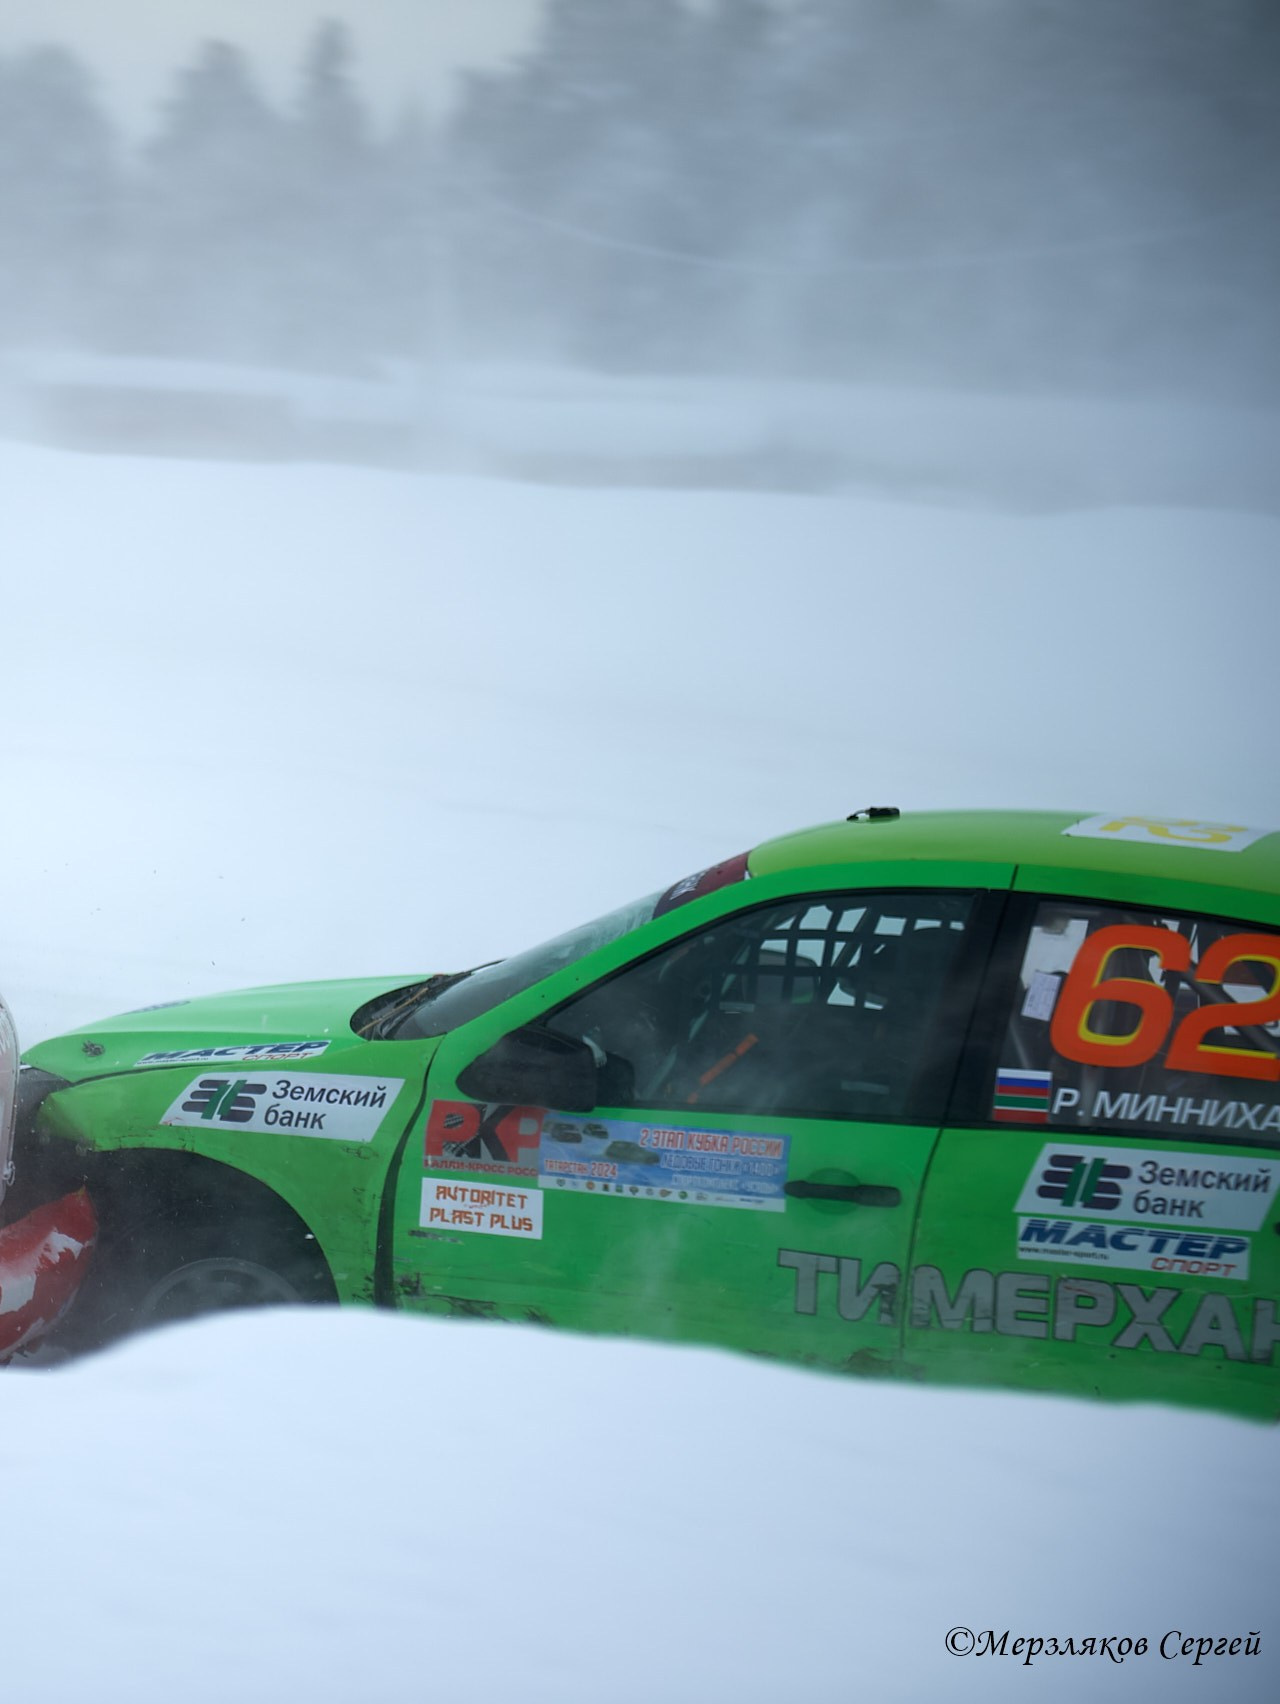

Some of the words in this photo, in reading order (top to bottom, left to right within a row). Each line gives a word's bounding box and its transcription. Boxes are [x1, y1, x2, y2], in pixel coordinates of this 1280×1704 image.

[1049, 924, 1280, 1082] 62
[142, 1040, 329, 1062] МАСТЕР
[242, 1052, 312, 1062] СПОРТ
[272, 1079, 387, 1109] Земский
[264, 1104, 327, 1130] банк
[640, 1129, 649, 1147] 2
[652, 1129, 685, 1149] ЭТАП
[687, 1132, 729, 1153] КУБКА
[731, 1136, 784, 1158] РОССИИ
[590, 1162, 617, 1179] 2024
[1137, 1160, 1272, 1194] Земский
[1133, 1189, 1205, 1219] банк
[430, 1207, 484, 1226] PLAST
[490, 1213, 532, 1231] PLUS
[1018, 1219, 1250, 1259] МАСТЕР
[1151, 1257, 1238, 1276] СПОРТ
